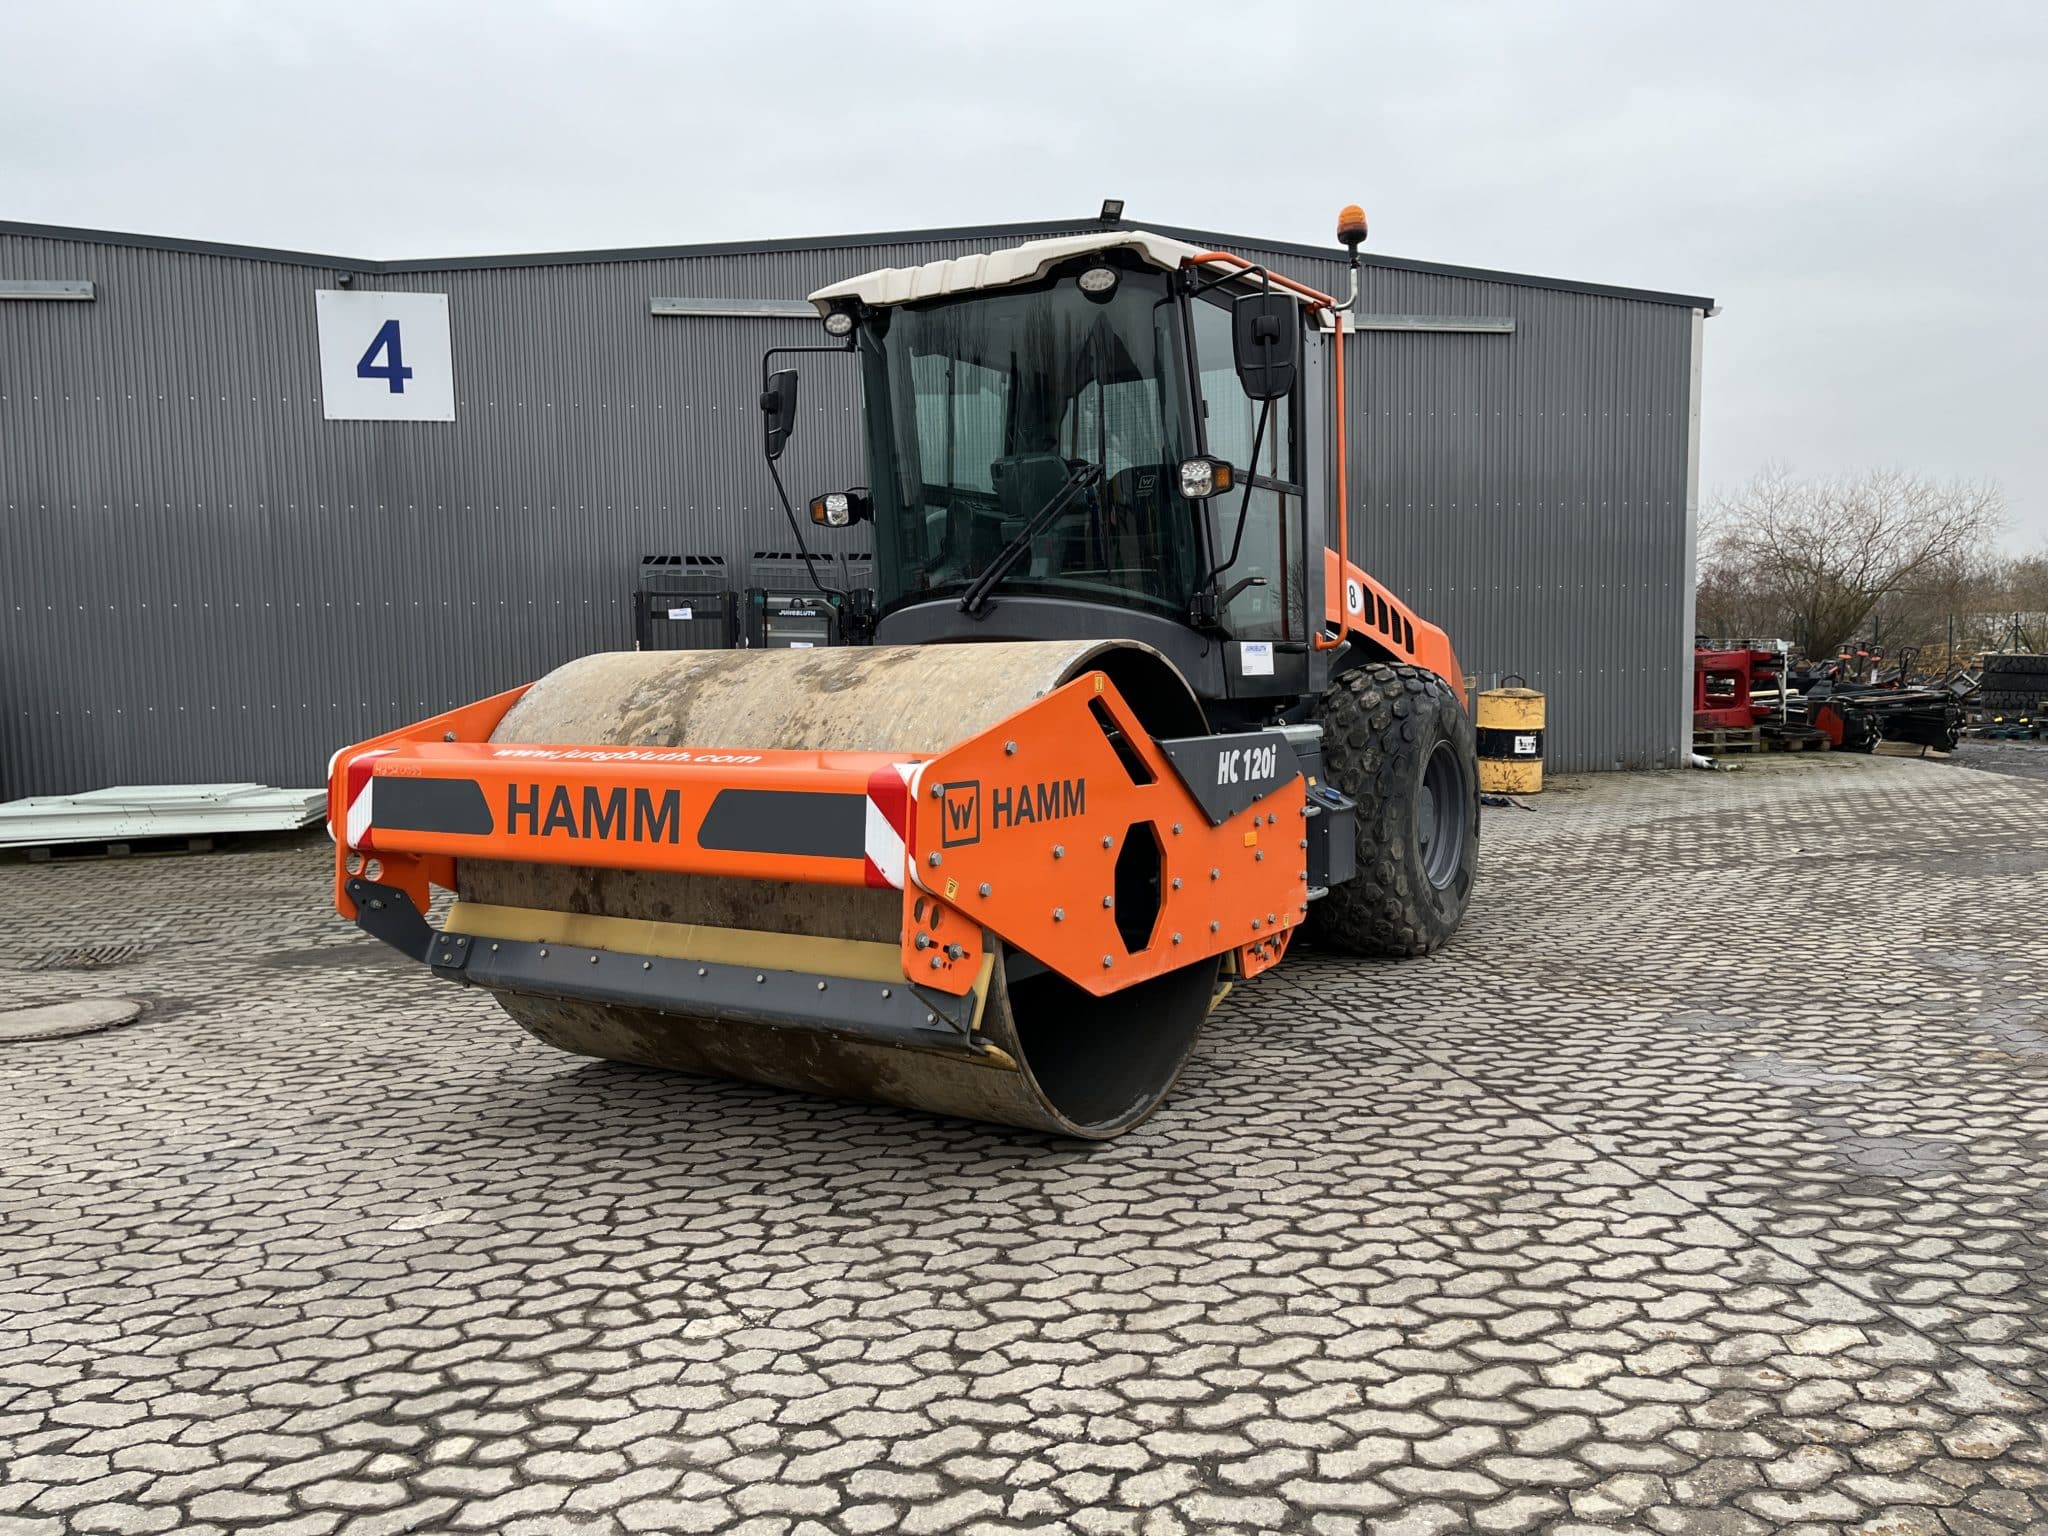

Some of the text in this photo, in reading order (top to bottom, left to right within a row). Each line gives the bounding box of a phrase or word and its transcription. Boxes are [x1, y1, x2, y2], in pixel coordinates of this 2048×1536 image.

[357, 319, 412, 393] 4
[1349, 585, 1356, 608] 8
[493, 748, 763, 764] www.jungbluth.com
[1218, 744, 1277, 785] HC 120i
[507, 784, 681, 844] HAMM
[948, 778, 1086, 831] W HAMM
